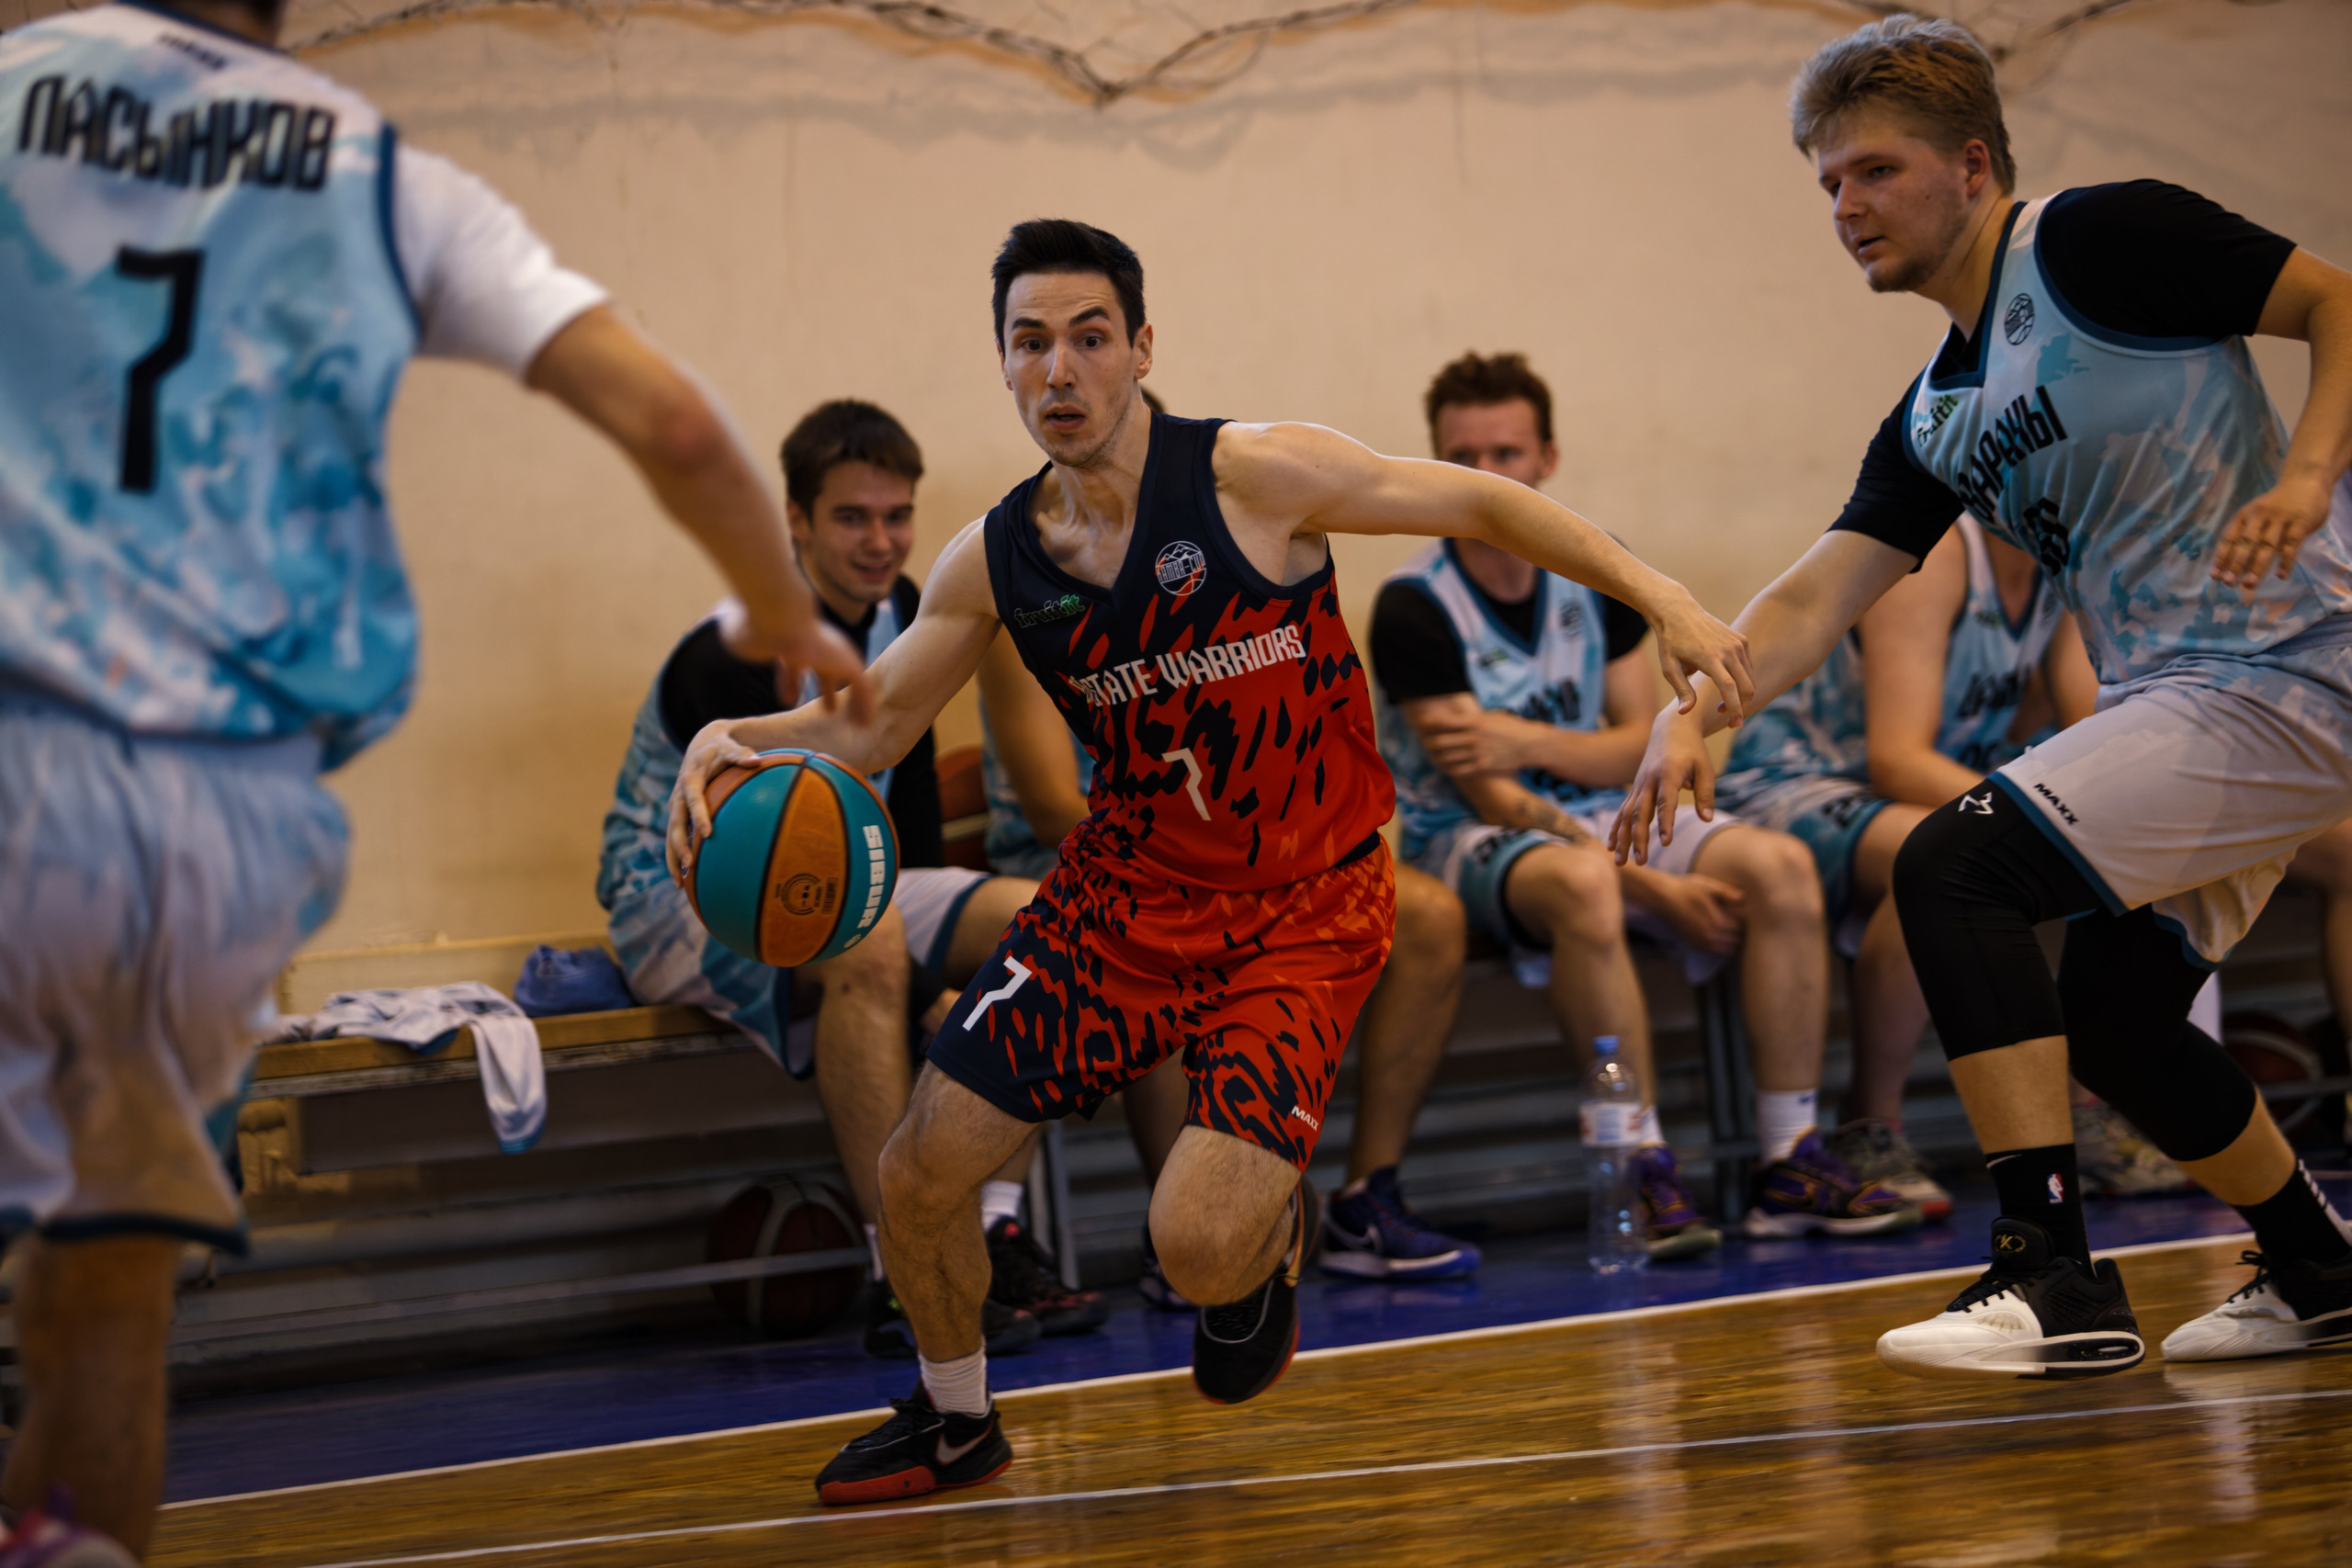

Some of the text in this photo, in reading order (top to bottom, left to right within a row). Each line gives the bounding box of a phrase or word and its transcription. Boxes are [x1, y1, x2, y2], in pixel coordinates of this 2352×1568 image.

[17, 73, 339, 192] ПАСЫНКОВ
[116, 243, 206, 495] 7
[1013, 594, 1086, 628] fruitit
[1155, 625, 1306, 688] WARRIORS
[1161, 747, 1212, 821] 7
[2033, 783, 2079, 825] MAXX
[856, 824, 886, 929] SIBUR
[962, 955, 1033, 1032] 7
[1291, 1105, 1319, 1132] MAXX
